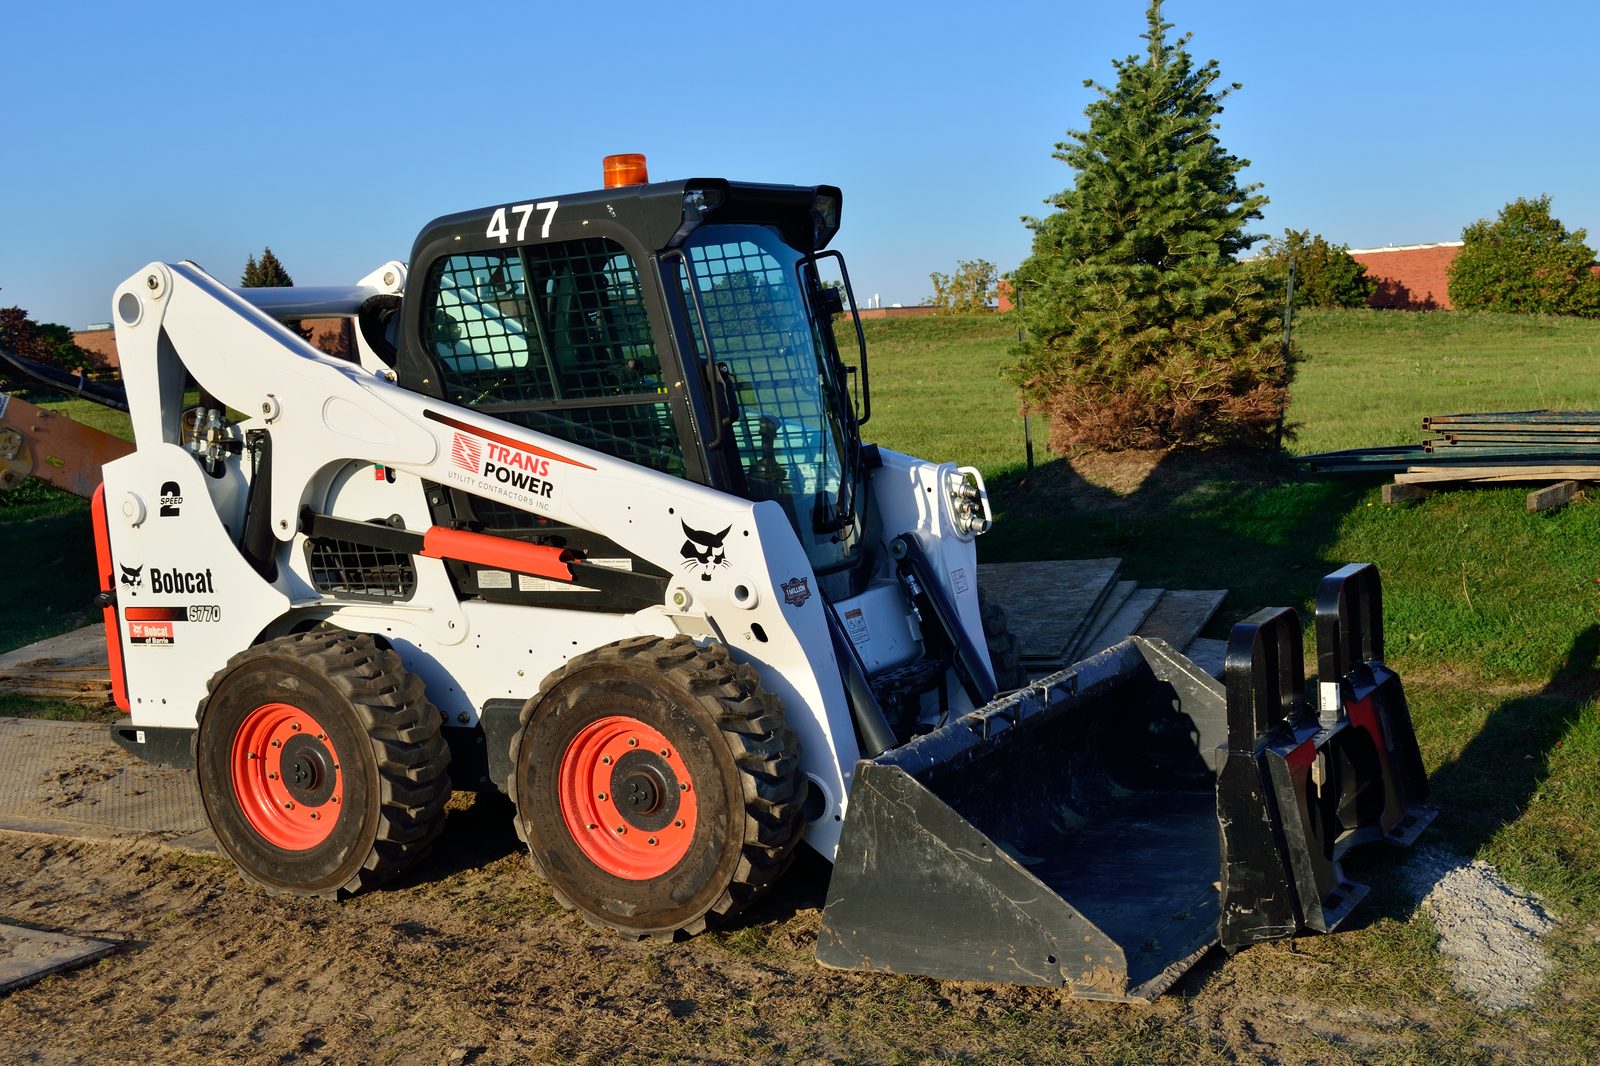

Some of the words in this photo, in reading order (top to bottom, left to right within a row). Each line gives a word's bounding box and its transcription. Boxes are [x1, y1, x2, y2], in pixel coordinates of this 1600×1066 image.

[486, 201, 558, 244] 477
[487, 442, 550, 477] TRANS
[447, 471, 476, 485] UTILITY
[477, 481, 534, 506] CONTRACTORS
[536, 500, 551, 512] INC.
[483, 462, 554, 498] POWER
[160, 481, 181, 517] 2
[160, 497, 184, 505] SPEED
[150, 568, 214, 594] Bobcat
[144, 625, 168, 636] Bobcat
[189, 605, 221, 622] S770
